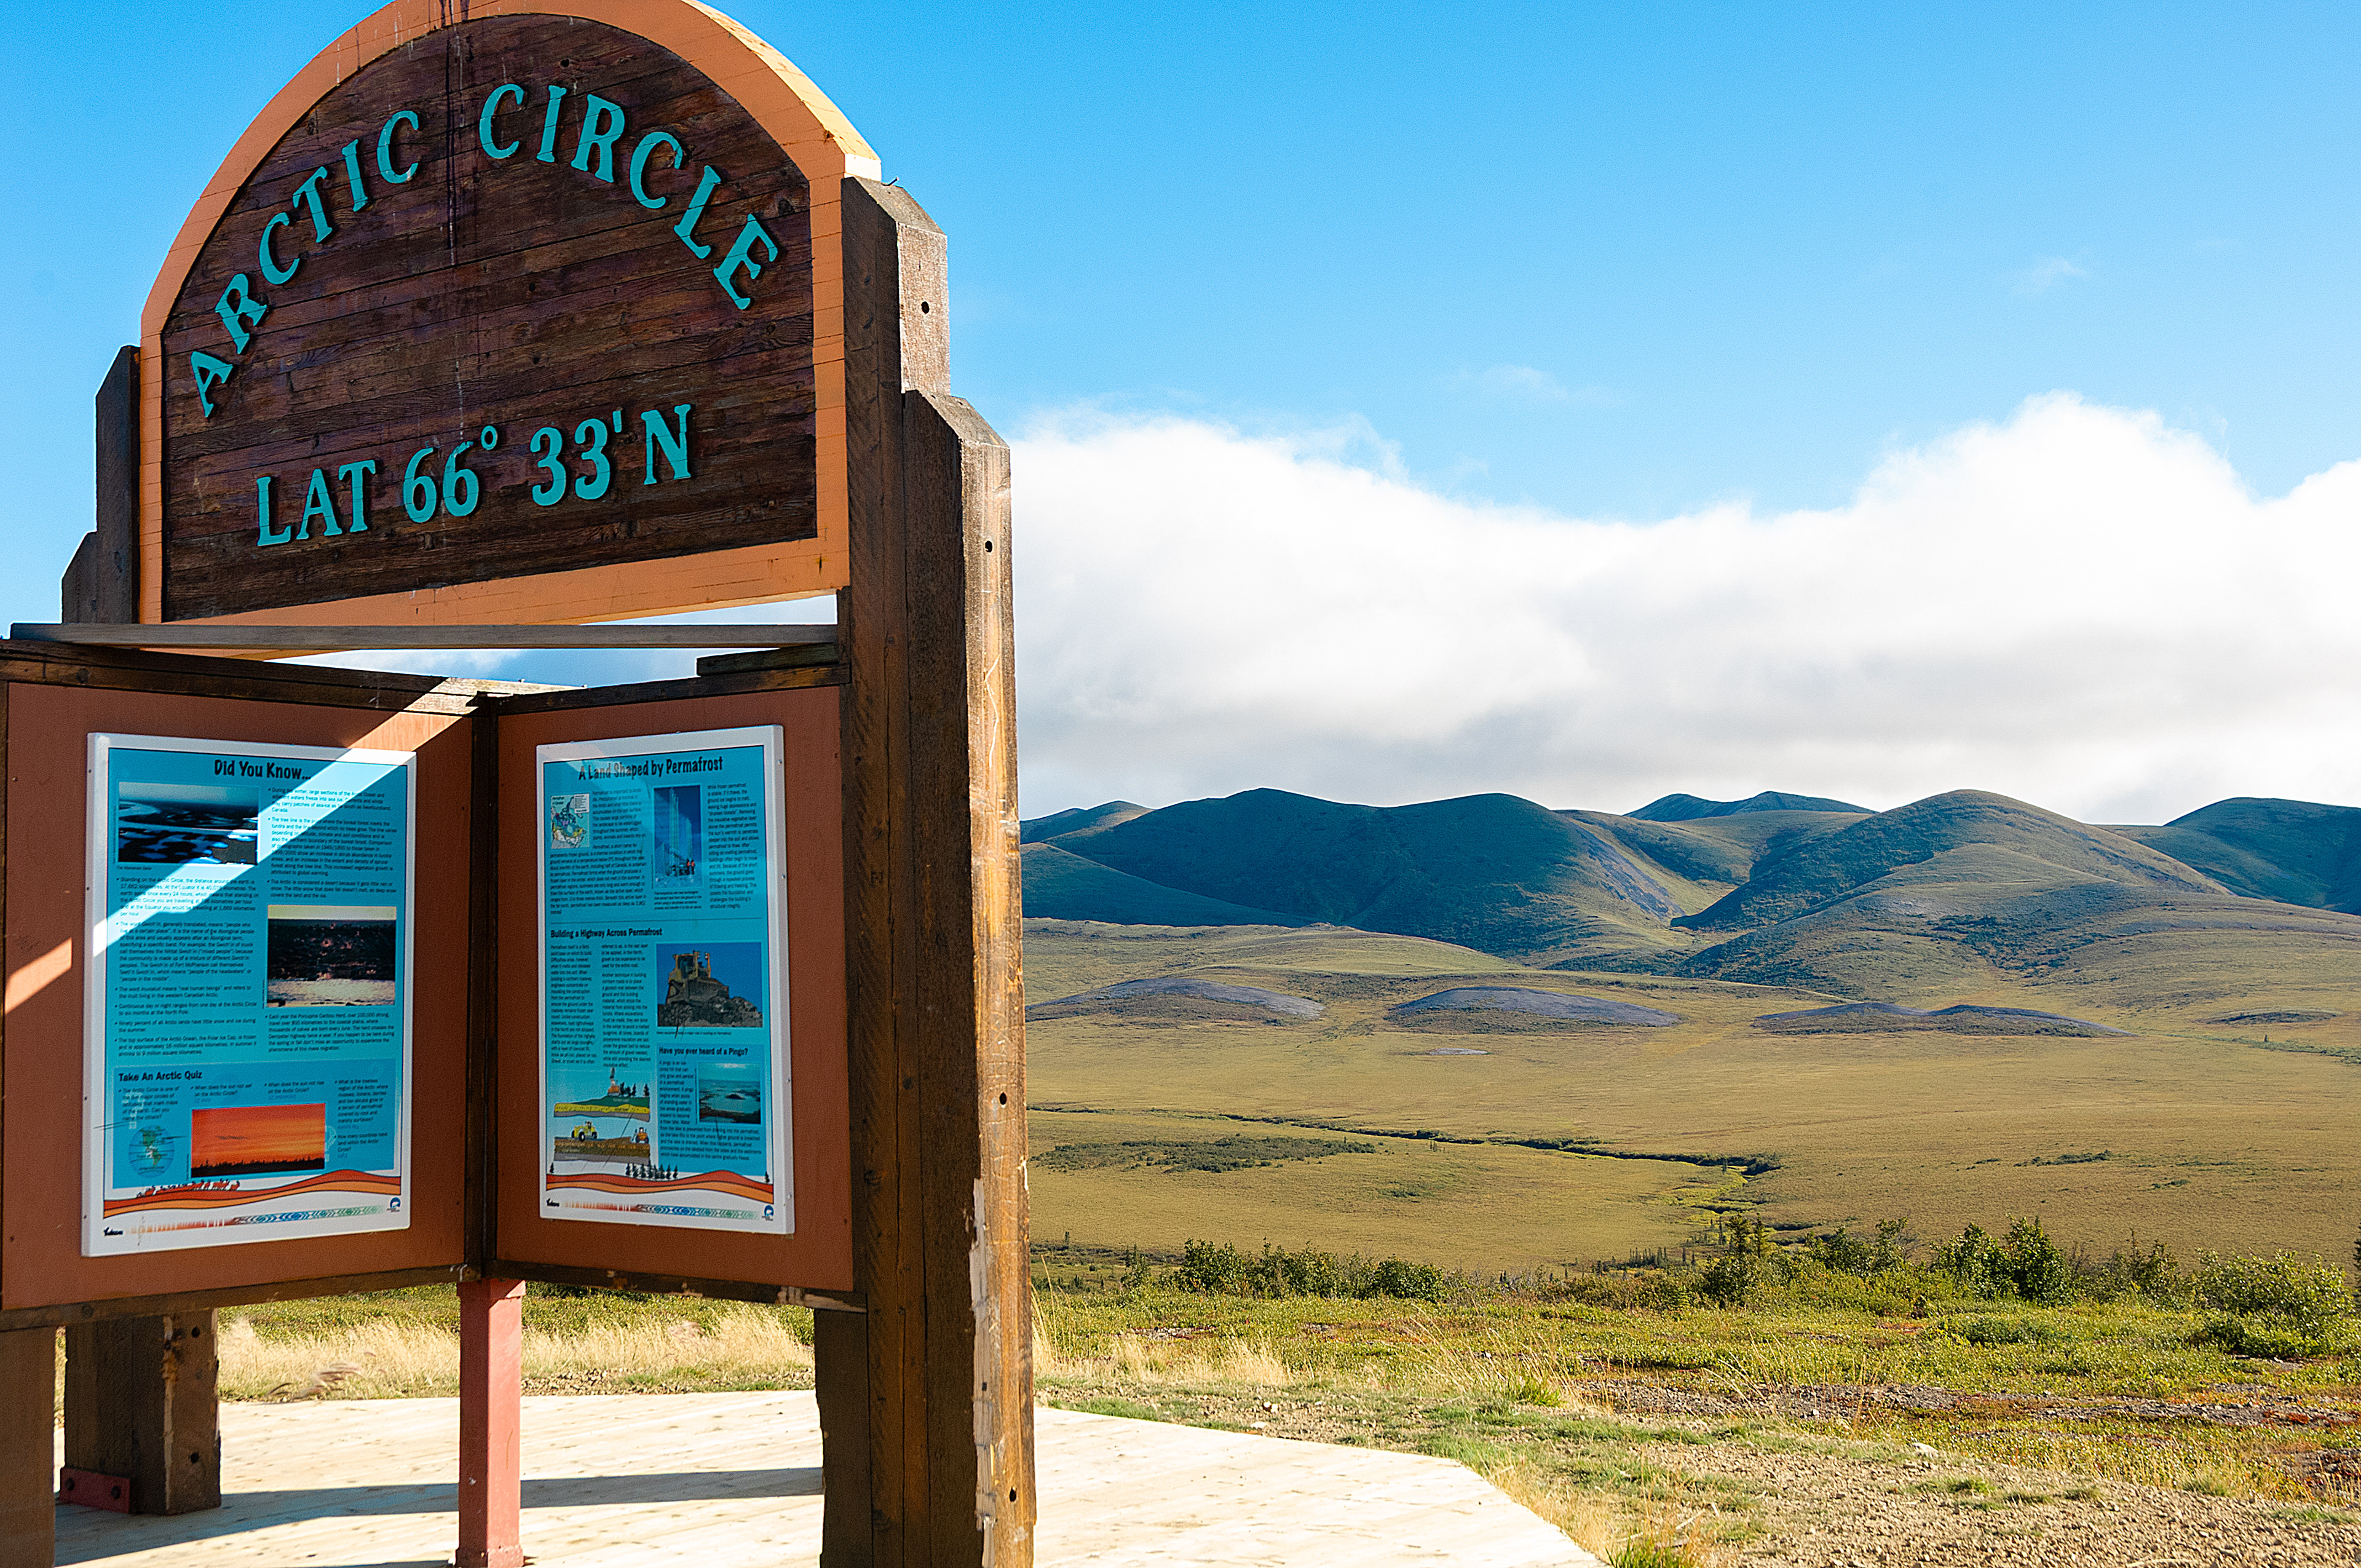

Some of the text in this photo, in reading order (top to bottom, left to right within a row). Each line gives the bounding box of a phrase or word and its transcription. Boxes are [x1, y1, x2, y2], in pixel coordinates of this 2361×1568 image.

[190, 83, 779, 418] ARCTIC CIRCLE
[256, 458, 377, 547] LAT
[403, 424, 498, 525] 66°
[214, 759, 312, 780] Did You Know...
[579, 756, 723, 780] A Land Shaped by Permafrost
[550, 930, 574, 939] Building
[580, 929, 605, 939] Highway
[628, 927, 662, 936] Permafrost
[729, 1048, 748, 1057] Pingo?
[119, 1070, 202, 1082] Take An Arctic Quiz
